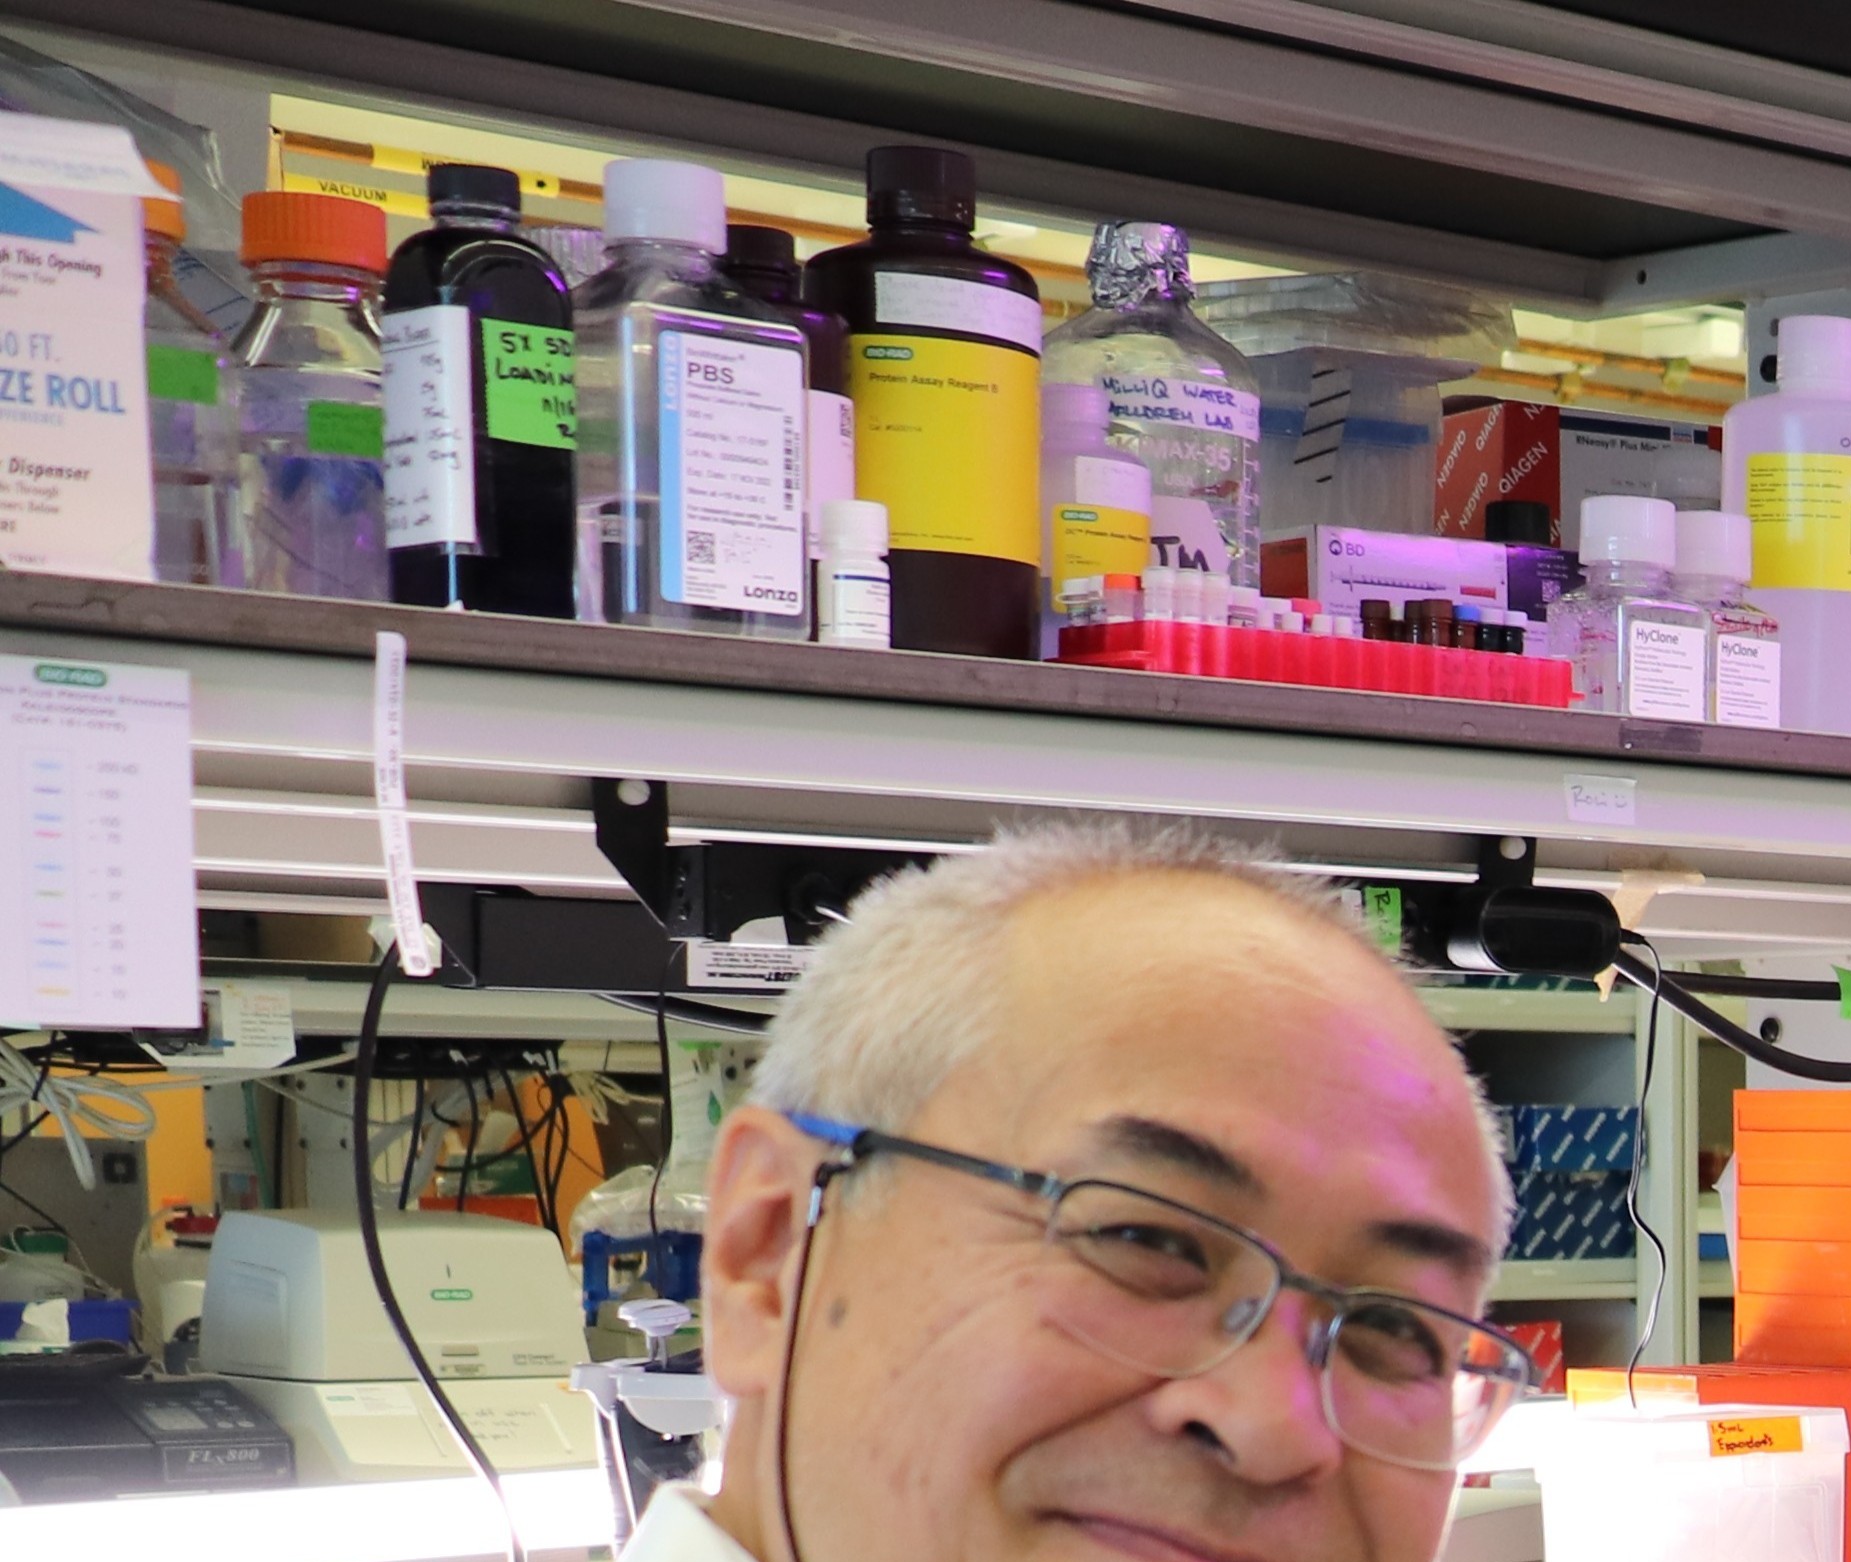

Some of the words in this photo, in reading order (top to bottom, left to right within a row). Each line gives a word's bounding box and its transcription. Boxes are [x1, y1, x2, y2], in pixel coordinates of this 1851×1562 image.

[319, 179, 388, 203] VACUUM
[16, 249, 43, 267] This
[47, 253, 103, 278] Opening
[665, 335, 678, 411] Lonza
[686, 361, 735, 385] PBS
[869, 371, 907, 384] Protein
[911, 374, 944, 388] Assay
[947, 377, 989, 393] Reagent
[46, 373, 126, 414] ROLL
[1205, 413, 1234, 431] LAB
[8, 456, 92, 483] Dispenser
[1436, 429, 1467, 490] QIAGEN
[1498, 441, 1550, 495] QIAGEN
[1458, 471, 1489, 531] QIAGEN
[1345, 542, 1365, 557] BD
[742, 584, 798, 603] Lonza
[1636, 627, 1679, 645] HyClone
[1721, 640, 1759, 658] HyClone
[433, 1290, 471, 1300] BIO-RAD
